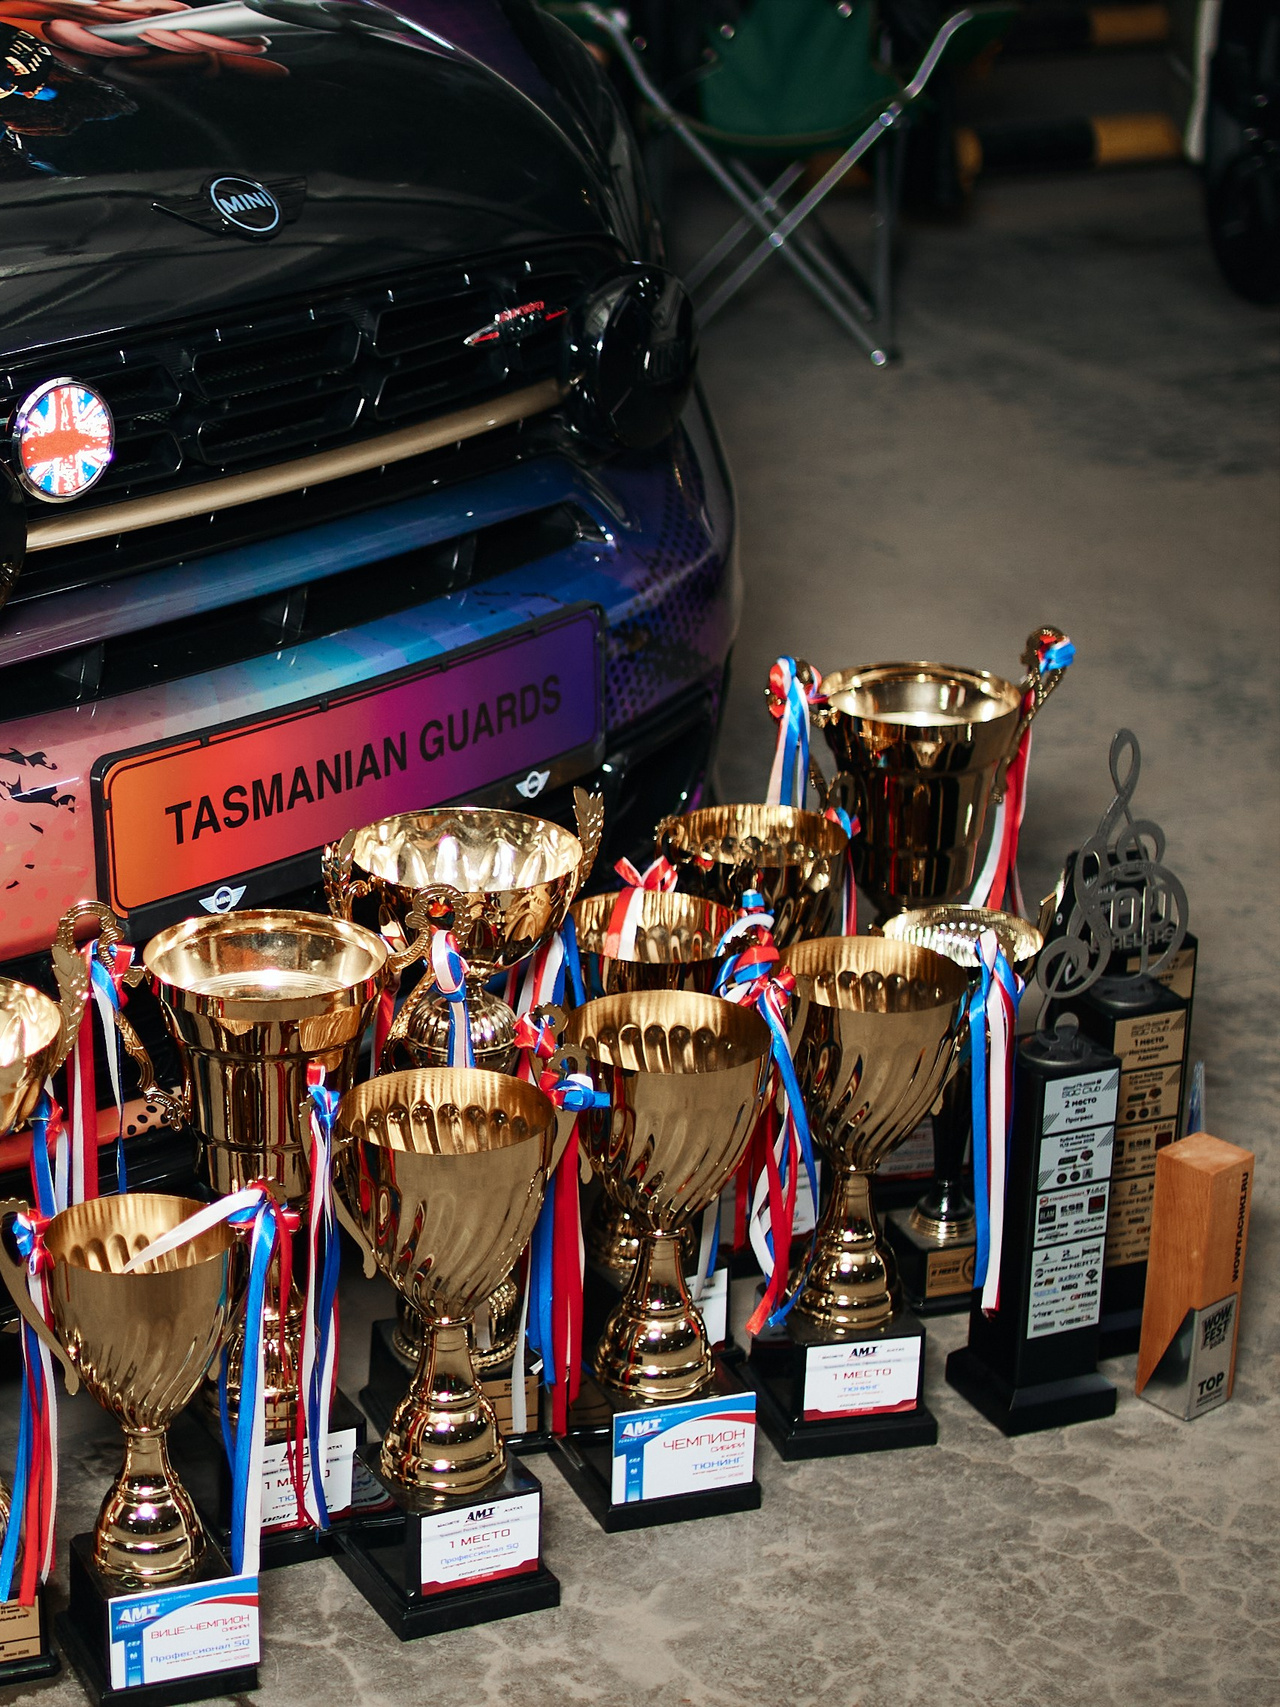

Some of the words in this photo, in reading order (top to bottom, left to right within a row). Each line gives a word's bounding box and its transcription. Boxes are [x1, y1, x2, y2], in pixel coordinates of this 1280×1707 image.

[219, 191, 271, 214] MINI
[165, 732, 407, 845] TASMANIAN
[419, 675, 562, 762] GUARDS
[1134, 1038, 1138, 1047] 1
[1063, 1099, 1070, 1109] 2
[1071, 1094, 1097, 1108] место
[832, 1372, 838, 1381] 1
[842, 1367, 892, 1380] МЕСТО
[1198, 1371, 1224, 1396] TOP
[622, 1417, 662, 1437] AMT
[662, 1428, 746, 1452] ЧЕМПИОН
[710, 1441, 745, 1453] СИБИРИ
[691, 1455, 744, 1471] ТЮНИНГ
[264, 1481, 270, 1490] 1
[448, 1540, 454, 1549] 1
[460, 1527, 511, 1547] МЕСТО
[439, 1544, 504, 1566] Профессионал
[505, 1541, 519, 1551] SQ
[118, 1602, 160, 1625] AMT
[150, 1613, 250, 1640] ВИЦЕ-ЧЕМПИОН
[149, 1641, 231, 1664] Профессионал
[233, 1638, 250, 1648] SQ
